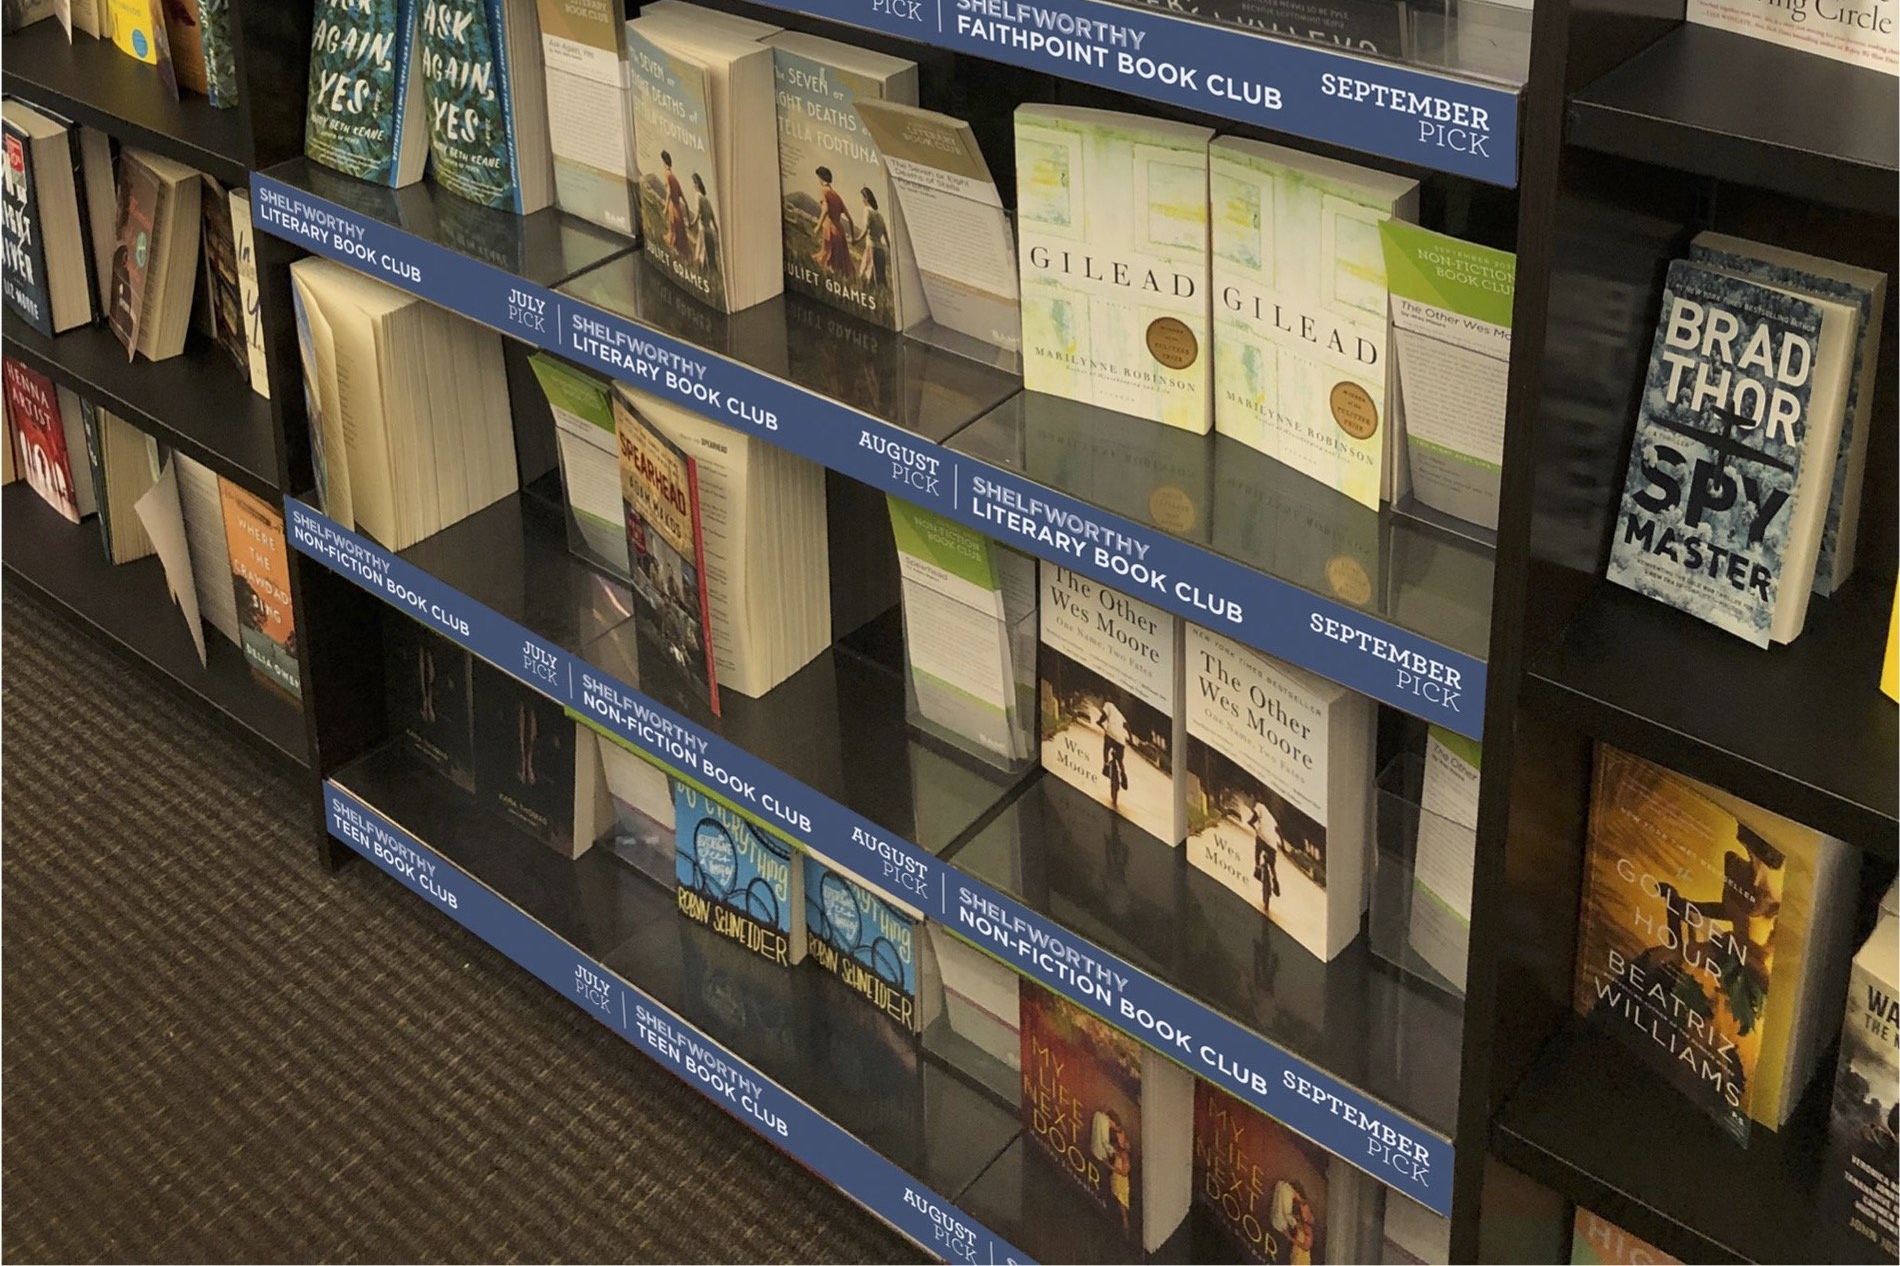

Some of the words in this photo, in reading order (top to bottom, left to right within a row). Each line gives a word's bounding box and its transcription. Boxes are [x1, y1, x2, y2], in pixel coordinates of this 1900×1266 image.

[312, 18, 394, 72] AGAIN,
[957, 14, 1108, 69] FAITHPOINT
[1118, 52, 1199, 91] BOOK
[1206, 73, 1282, 110] CLUB
[317, 69, 370, 114] YES
[1321, 73, 1490, 131] SEPTEMBER
[1419, 120, 1490, 158] PICK
[259, 187, 365, 241] SHELFWORTHY
[261, 204, 329, 244] LITERARY
[333, 234, 377, 265] BOOK
[381, 254, 421, 282] CLUB
[508, 288, 546, 315] JULY
[1030, 246, 1195, 298] GILEAD
[509, 305, 545, 333] PICK
[572, 314, 707, 381] SHELFWORTHY
[1664, 297, 1812, 388] BRAD
[573, 332, 660, 382] LITERARY
[666, 372, 722, 408] BOOK
[727, 397, 779, 431] CLUB
[619, 432, 687, 516] SPEARHEAD
[859, 431, 940, 475] AUGUST
[891, 461, 939, 496] PICK
[972, 476, 1150, 561] SHELFWORTHY
[1632, 444, 1792, 552] SPY
[292, 511, 390, 574] SHELFWORTHY
[294, 525, 383, 587] NON-FICTION
[386, 578, 428, 614] BOOK
[431, 605, 470, 636] CLUB
[973, 497, 1087, 559] LITERARY
[1095, 547, 1167, 595] BOOK
[1175, 582, 1244, 624] CLUB
[1624, 514, 1772, 603] MASTER
[523, 641, 558, 669] JULY
[523, 654, 558, 686] PICK
[1310, 612, 1463, 690] SEPTEMBER
[582, 674, 708, 755] SHELFWORTHY
[1198, 675, 1239, 719] Wes
[1247, 709, 1314, 771] Moore
[1200, 650, 1242, 693] The
[1249, 685, 1311, 742] Other
[1396, 668, 1460, 713] PICK
[583, 691, 698, 768] NON-FICTION
[703, 759, 756, 803] BOOK
[761, 794, 812, 834] CLUB
[332, 798, 435, 877] SHELFWORTHY
[333, 814, 370, 849] TEEN
[373, 841, 416, 881] BOOK
[419, 874, 458, 909] CLUB
[850, 827, 928, 880] AUGUST
[882, 860, 929, 900] PICK
[959, 887, 1129, 993] SHELFWORTHY
[574, 964, 610, 997] JULY
[575, 979, 610, 1015] PICK
[959, 906, 1112, 1007] NON-FICTION
[1120, 997, 1193, 1055] BOOK
[1199, 1045, 1269, 1096] CLUB
[1608, 950, 1735, 1063] BEATRIZ
[636, 1004, 763, 1100] SHELFWORTHY
[636, 1023, 681, 1064] TEEN
[685, 1055, 737, 1103] BOOK
[741, 1095, 789, 1137] CLUB
[1594, 975, 1740, 1107] WILLIAMS
[1282, 1069, 1431, 1167] SEPTEMBER
[1367, 1137, 1431, 1188] PICK
[903, 1188, 976, 1245] AUGUST
[934, 1225, 978, 1265] PICK
